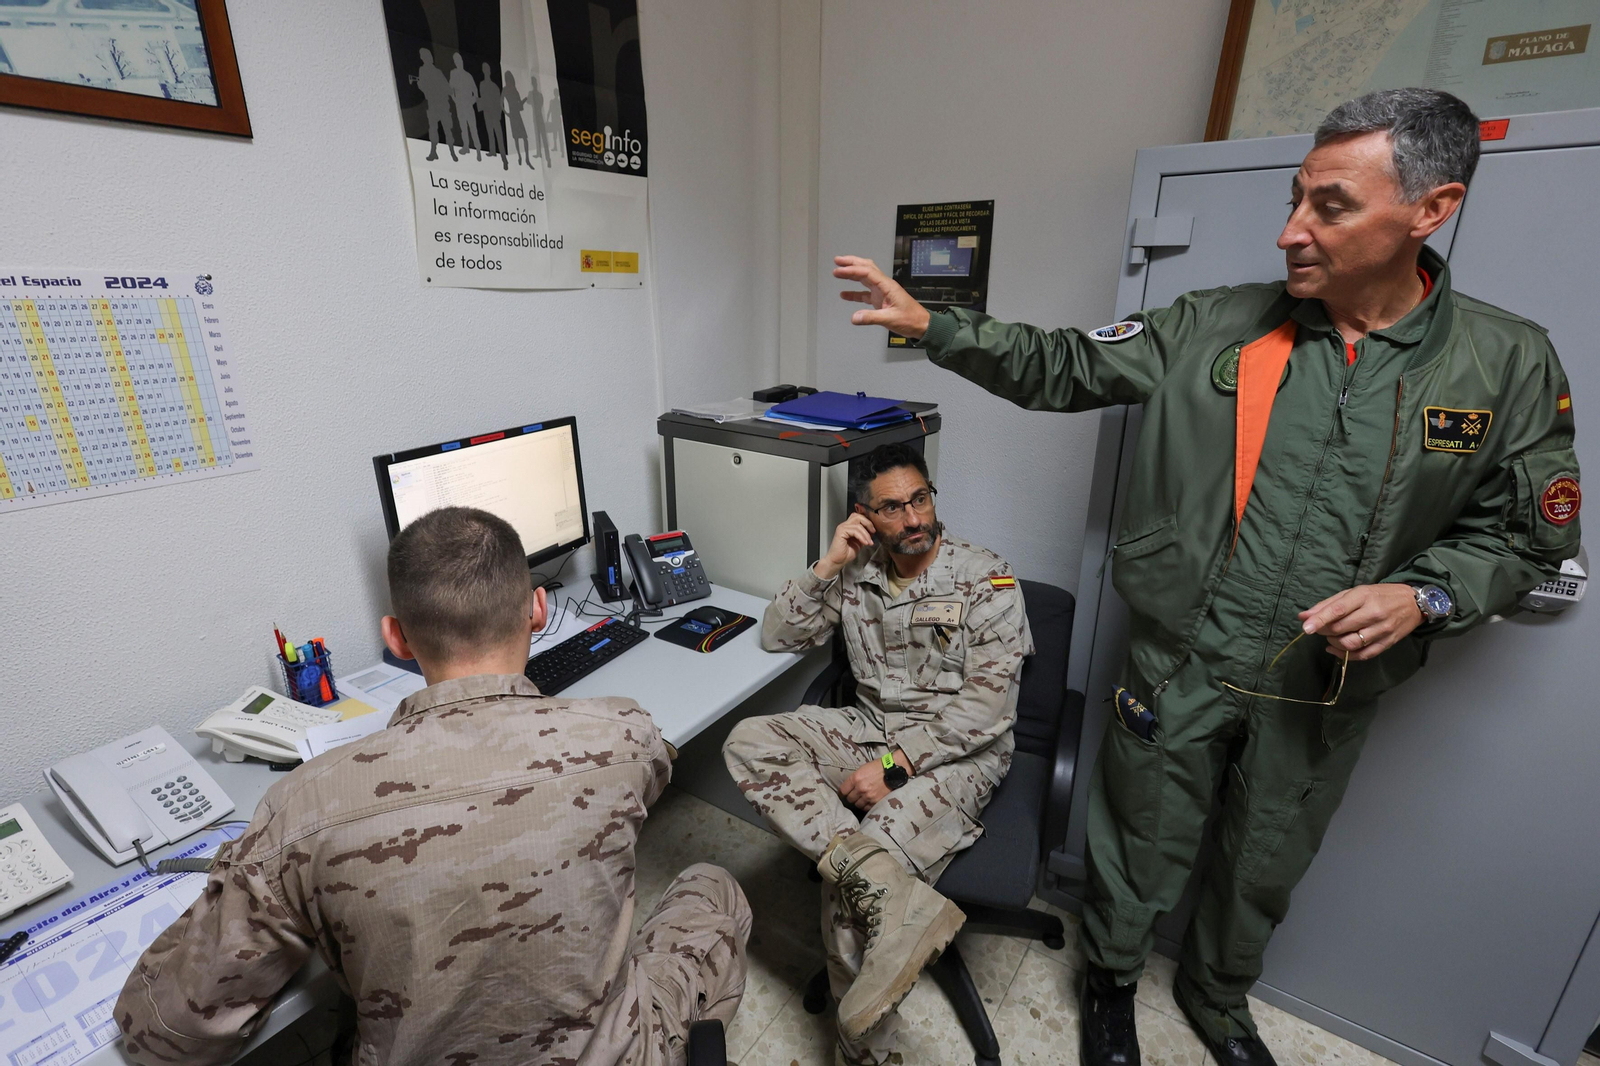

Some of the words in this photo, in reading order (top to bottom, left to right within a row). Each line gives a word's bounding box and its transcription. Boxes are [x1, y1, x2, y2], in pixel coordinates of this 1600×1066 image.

[1520, 34, 1552, 44] PLANO
[1508, 40, 1576, 58] MALAGA
[571, 125, 642, 154] seginfo
[429, 171, 448, 189] La
[454, 180, 524, 198] seguridad
[528, 184, 545, 201] de
[434, 198, 448, 216] la
[453, 200, 536, 224] información
[434, 231, 452, 242] es
[457, 232, 564, 250] responsabilidad
[435, 252, 456, 269] de
[460, 254, 502, 270] todos
[0, 276, 17, 286] el
[21, 276, 82, 289] Espacio
[104, 276, 169, 289] 2024
[1428, 438, 1463, 448] ESPRESATI
[1554, 503, 1571, 513] 2000
[61, 901, 87, 917] del
[89, 886, 119, 904] Aire
